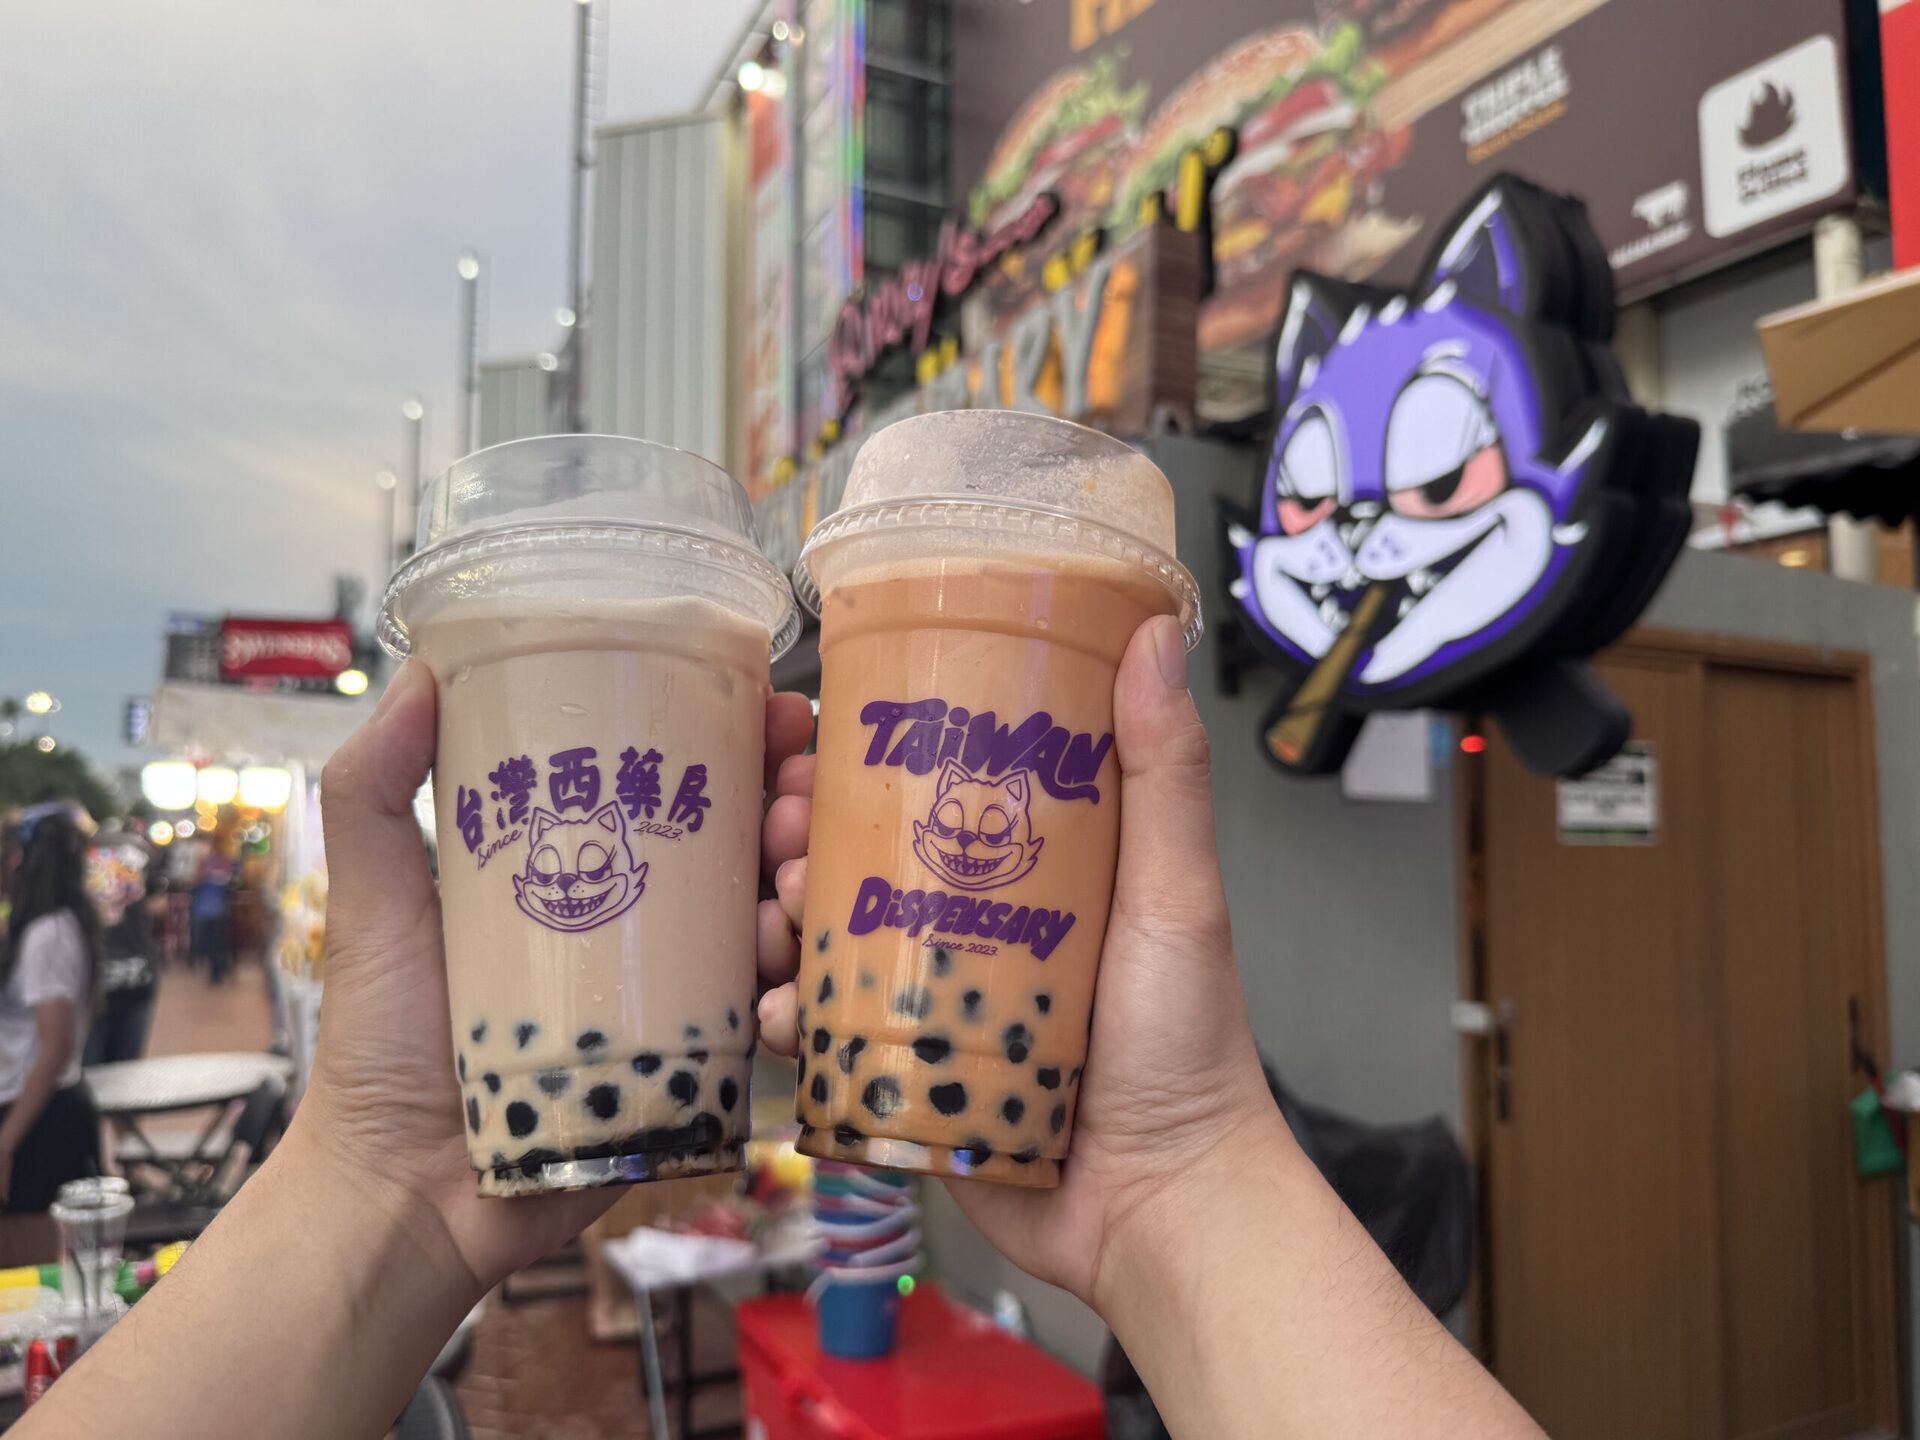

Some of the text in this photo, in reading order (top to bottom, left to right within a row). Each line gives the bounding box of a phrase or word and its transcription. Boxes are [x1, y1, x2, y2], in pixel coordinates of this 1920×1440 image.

[456, 746, 712, 854] 台灣西藥房
